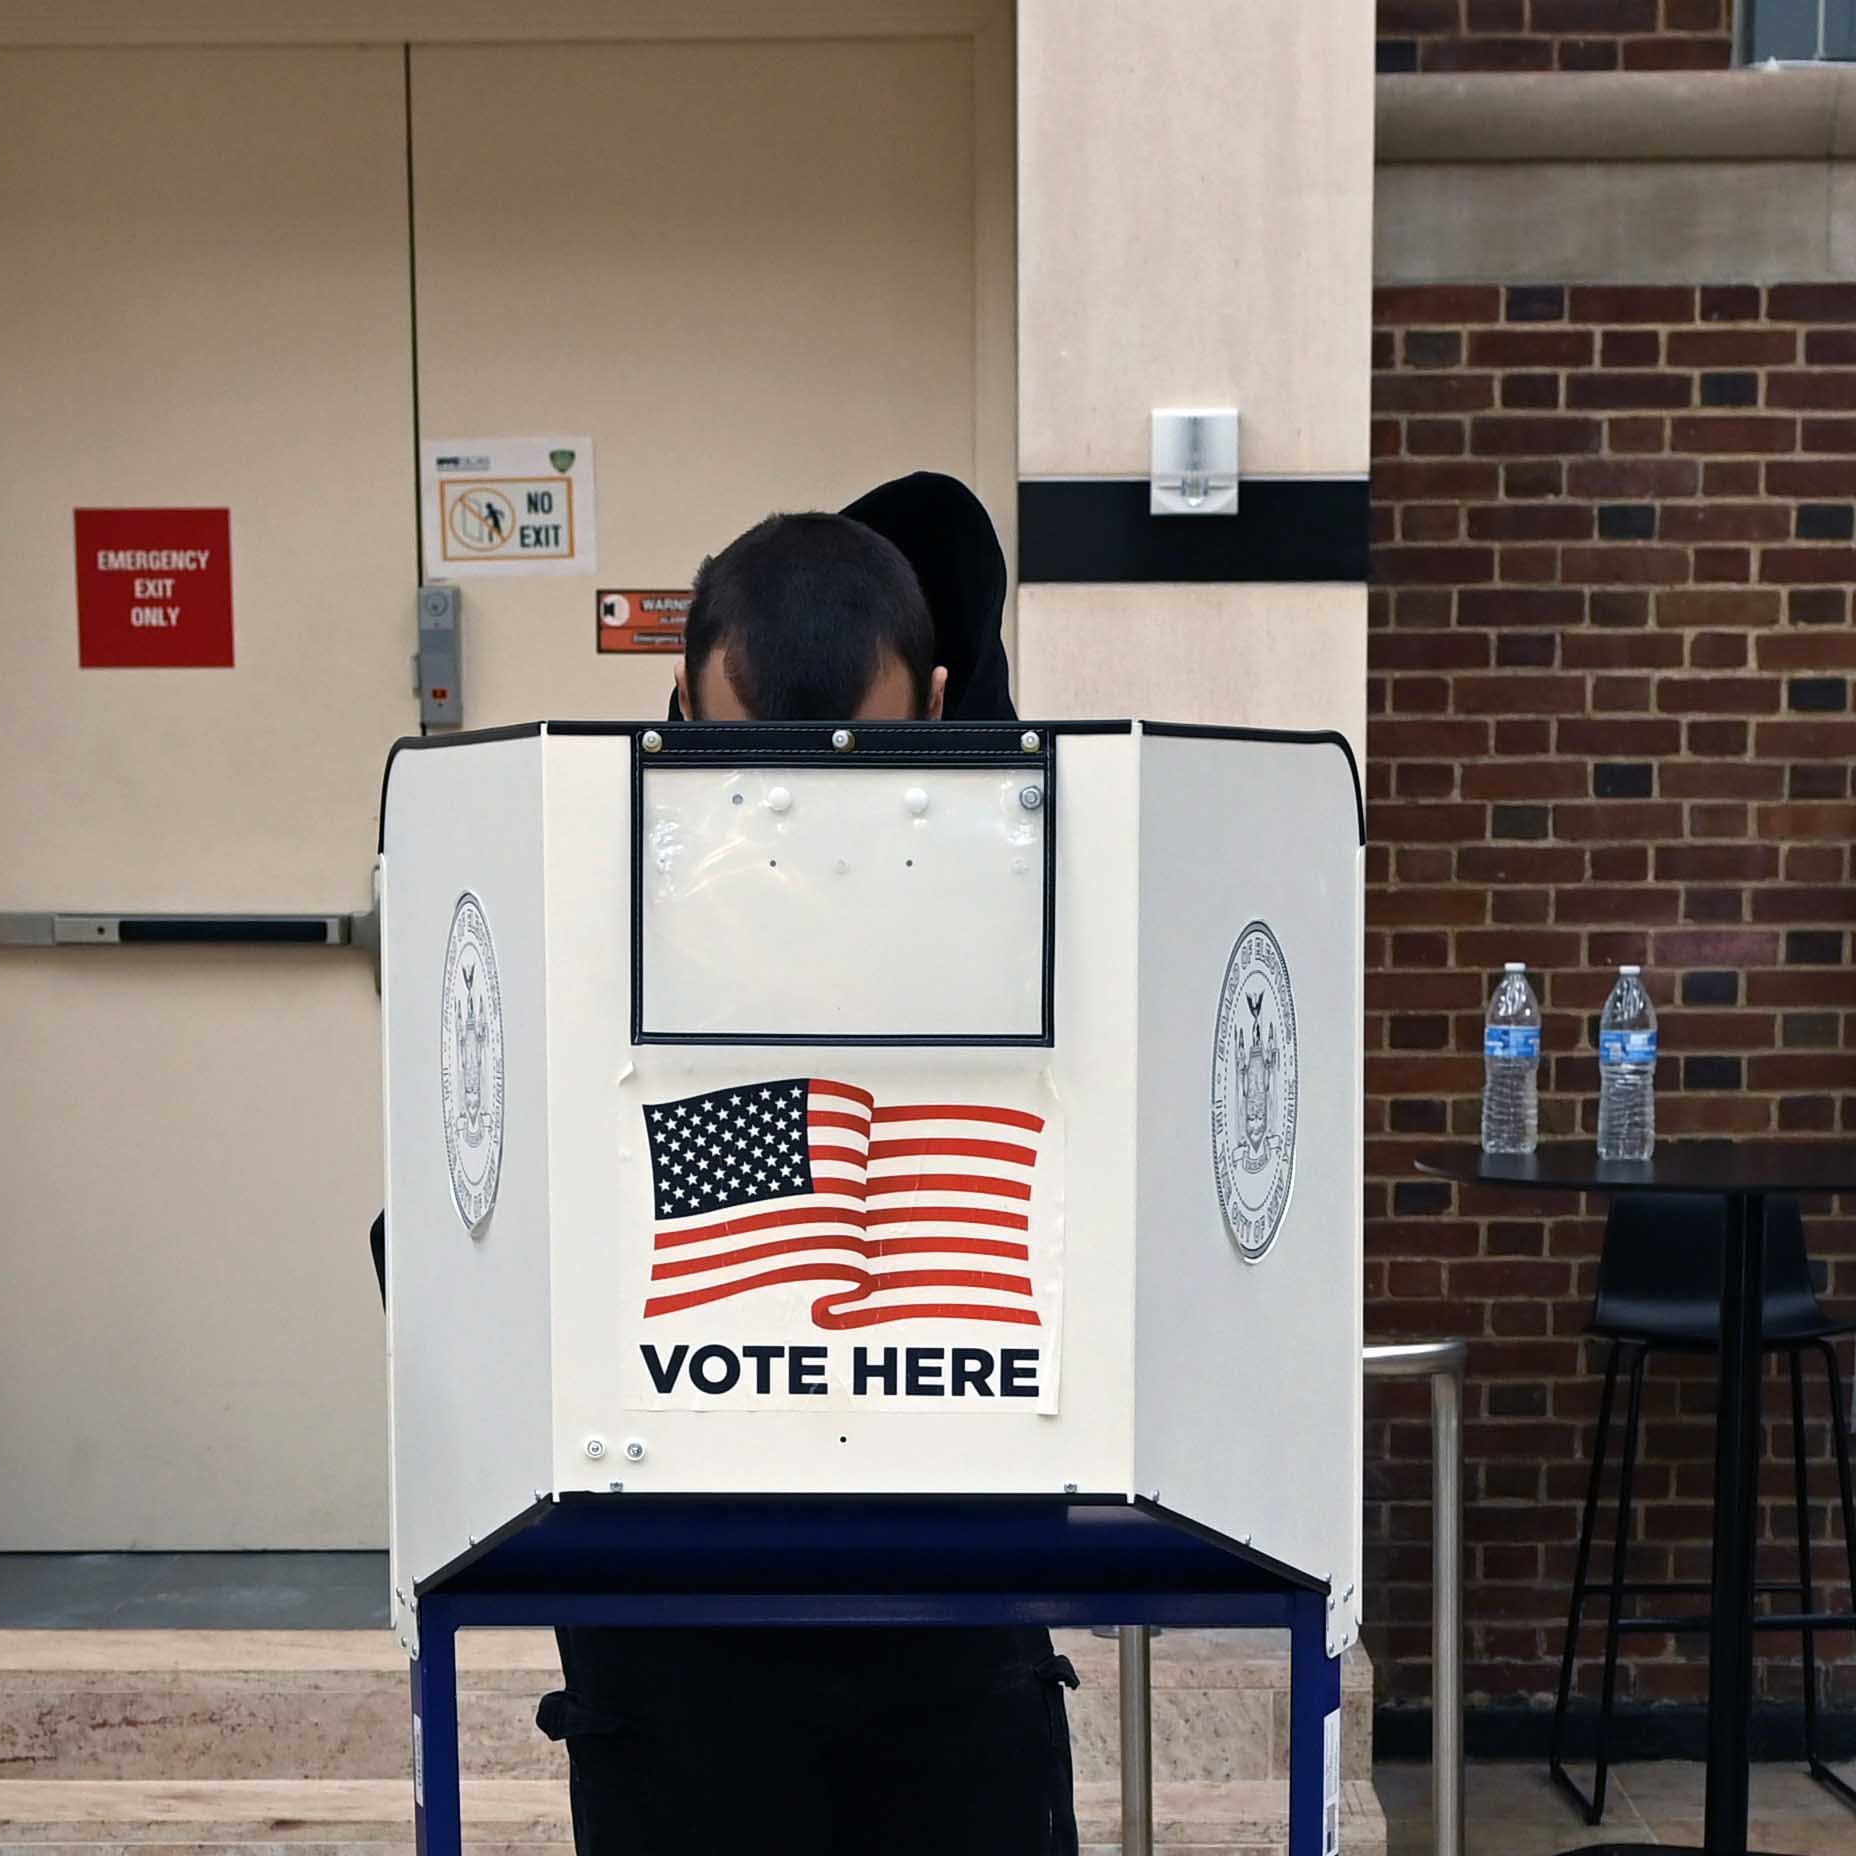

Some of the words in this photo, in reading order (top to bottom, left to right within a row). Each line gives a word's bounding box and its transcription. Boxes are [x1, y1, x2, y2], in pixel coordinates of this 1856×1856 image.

[526, 491, 553, 514] NO
[520, 525, 562, 548] EXIT
[97, 550, 210, 570] EMERGENCY
[134, 578, 175, 598] EXIT
[130, 606, 180, 627] ONLY
[639, 1343, 829, 1396] VOTE
[852, 1346, 1040, 1398] HERE
